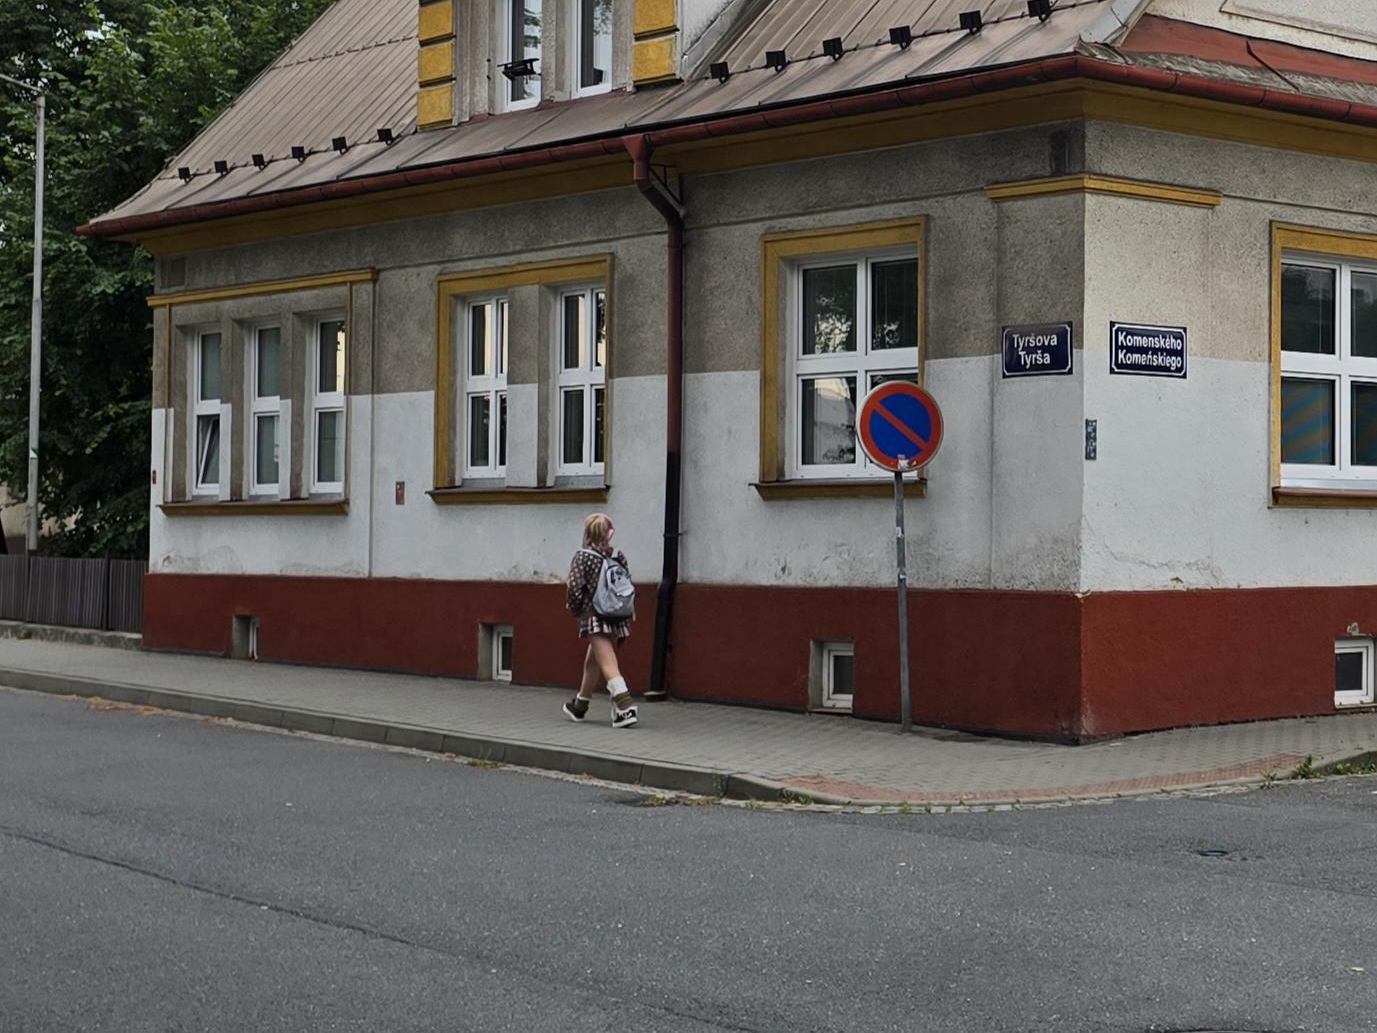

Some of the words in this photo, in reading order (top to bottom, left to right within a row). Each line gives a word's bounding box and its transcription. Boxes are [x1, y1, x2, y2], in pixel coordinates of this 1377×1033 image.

[1012, 333, 1058, 350] Tyršova
[1118, 331, 1182, 350] Komenského
[1018, 350, 1051, 369] Tyrša
[1118, 349, 1182, 370] Komeńskiego
